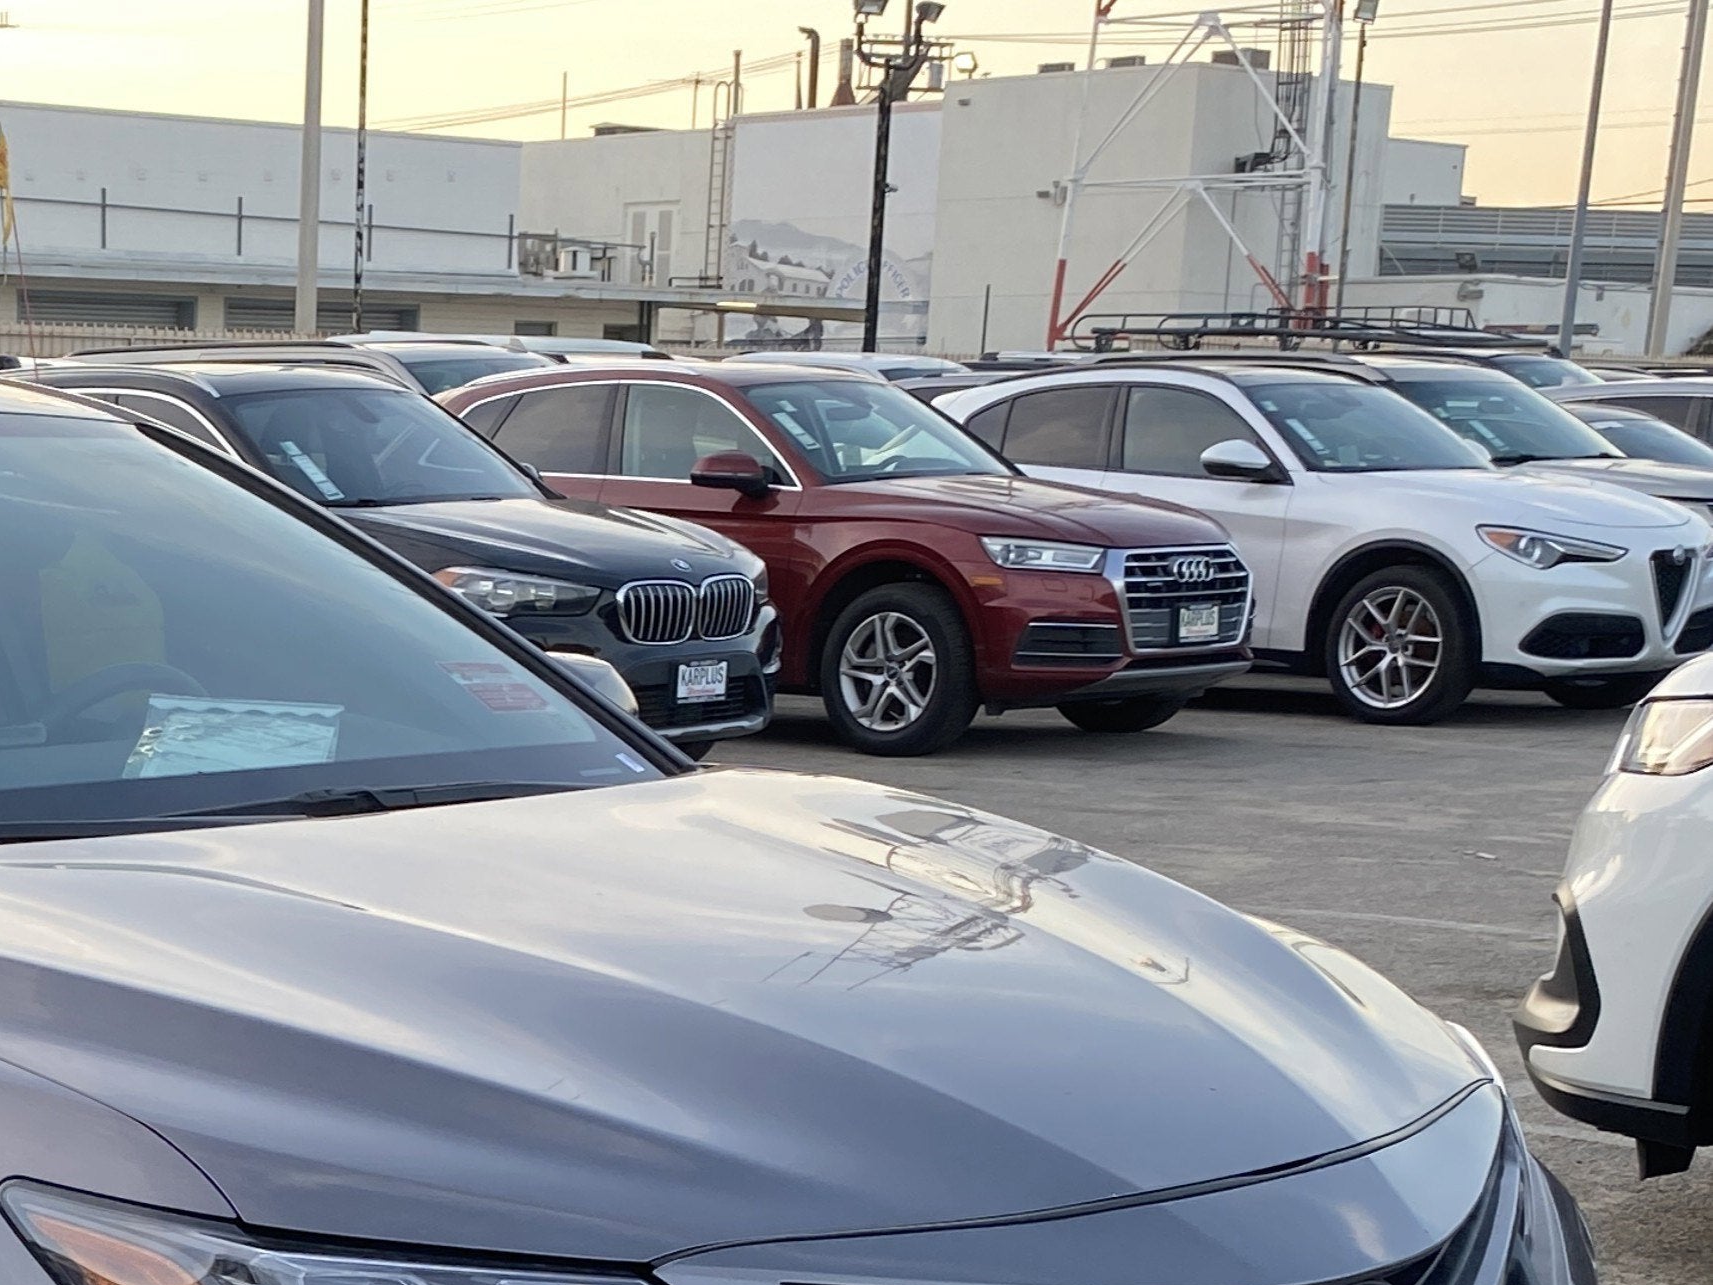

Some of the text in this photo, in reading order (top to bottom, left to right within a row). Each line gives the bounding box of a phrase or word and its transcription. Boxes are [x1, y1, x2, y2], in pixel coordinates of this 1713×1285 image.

[835, 260, 910, 299] POLIC FFICER
[681, 666, 724, 687] KARPLUS
